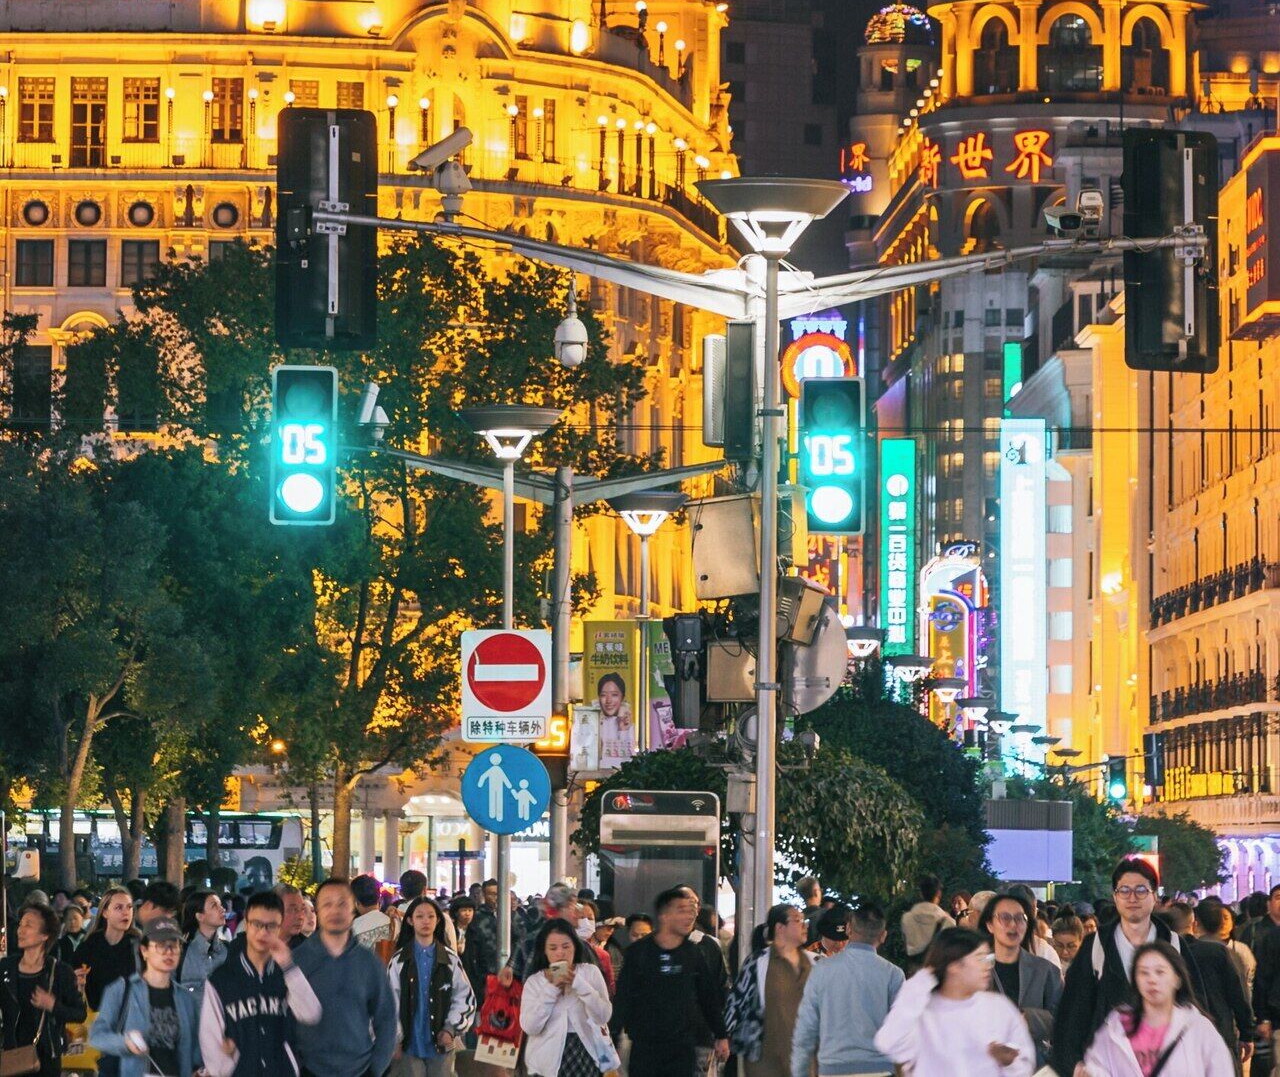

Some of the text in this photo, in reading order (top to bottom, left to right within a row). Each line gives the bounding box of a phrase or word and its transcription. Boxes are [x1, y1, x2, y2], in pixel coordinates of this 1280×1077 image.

[919, 130, 1054, 191] 新世界
[281, 424, 326, 465] 05
[809, 434, 855, 476] 05
[470, 720, 543, 736] 除特种车辆外
